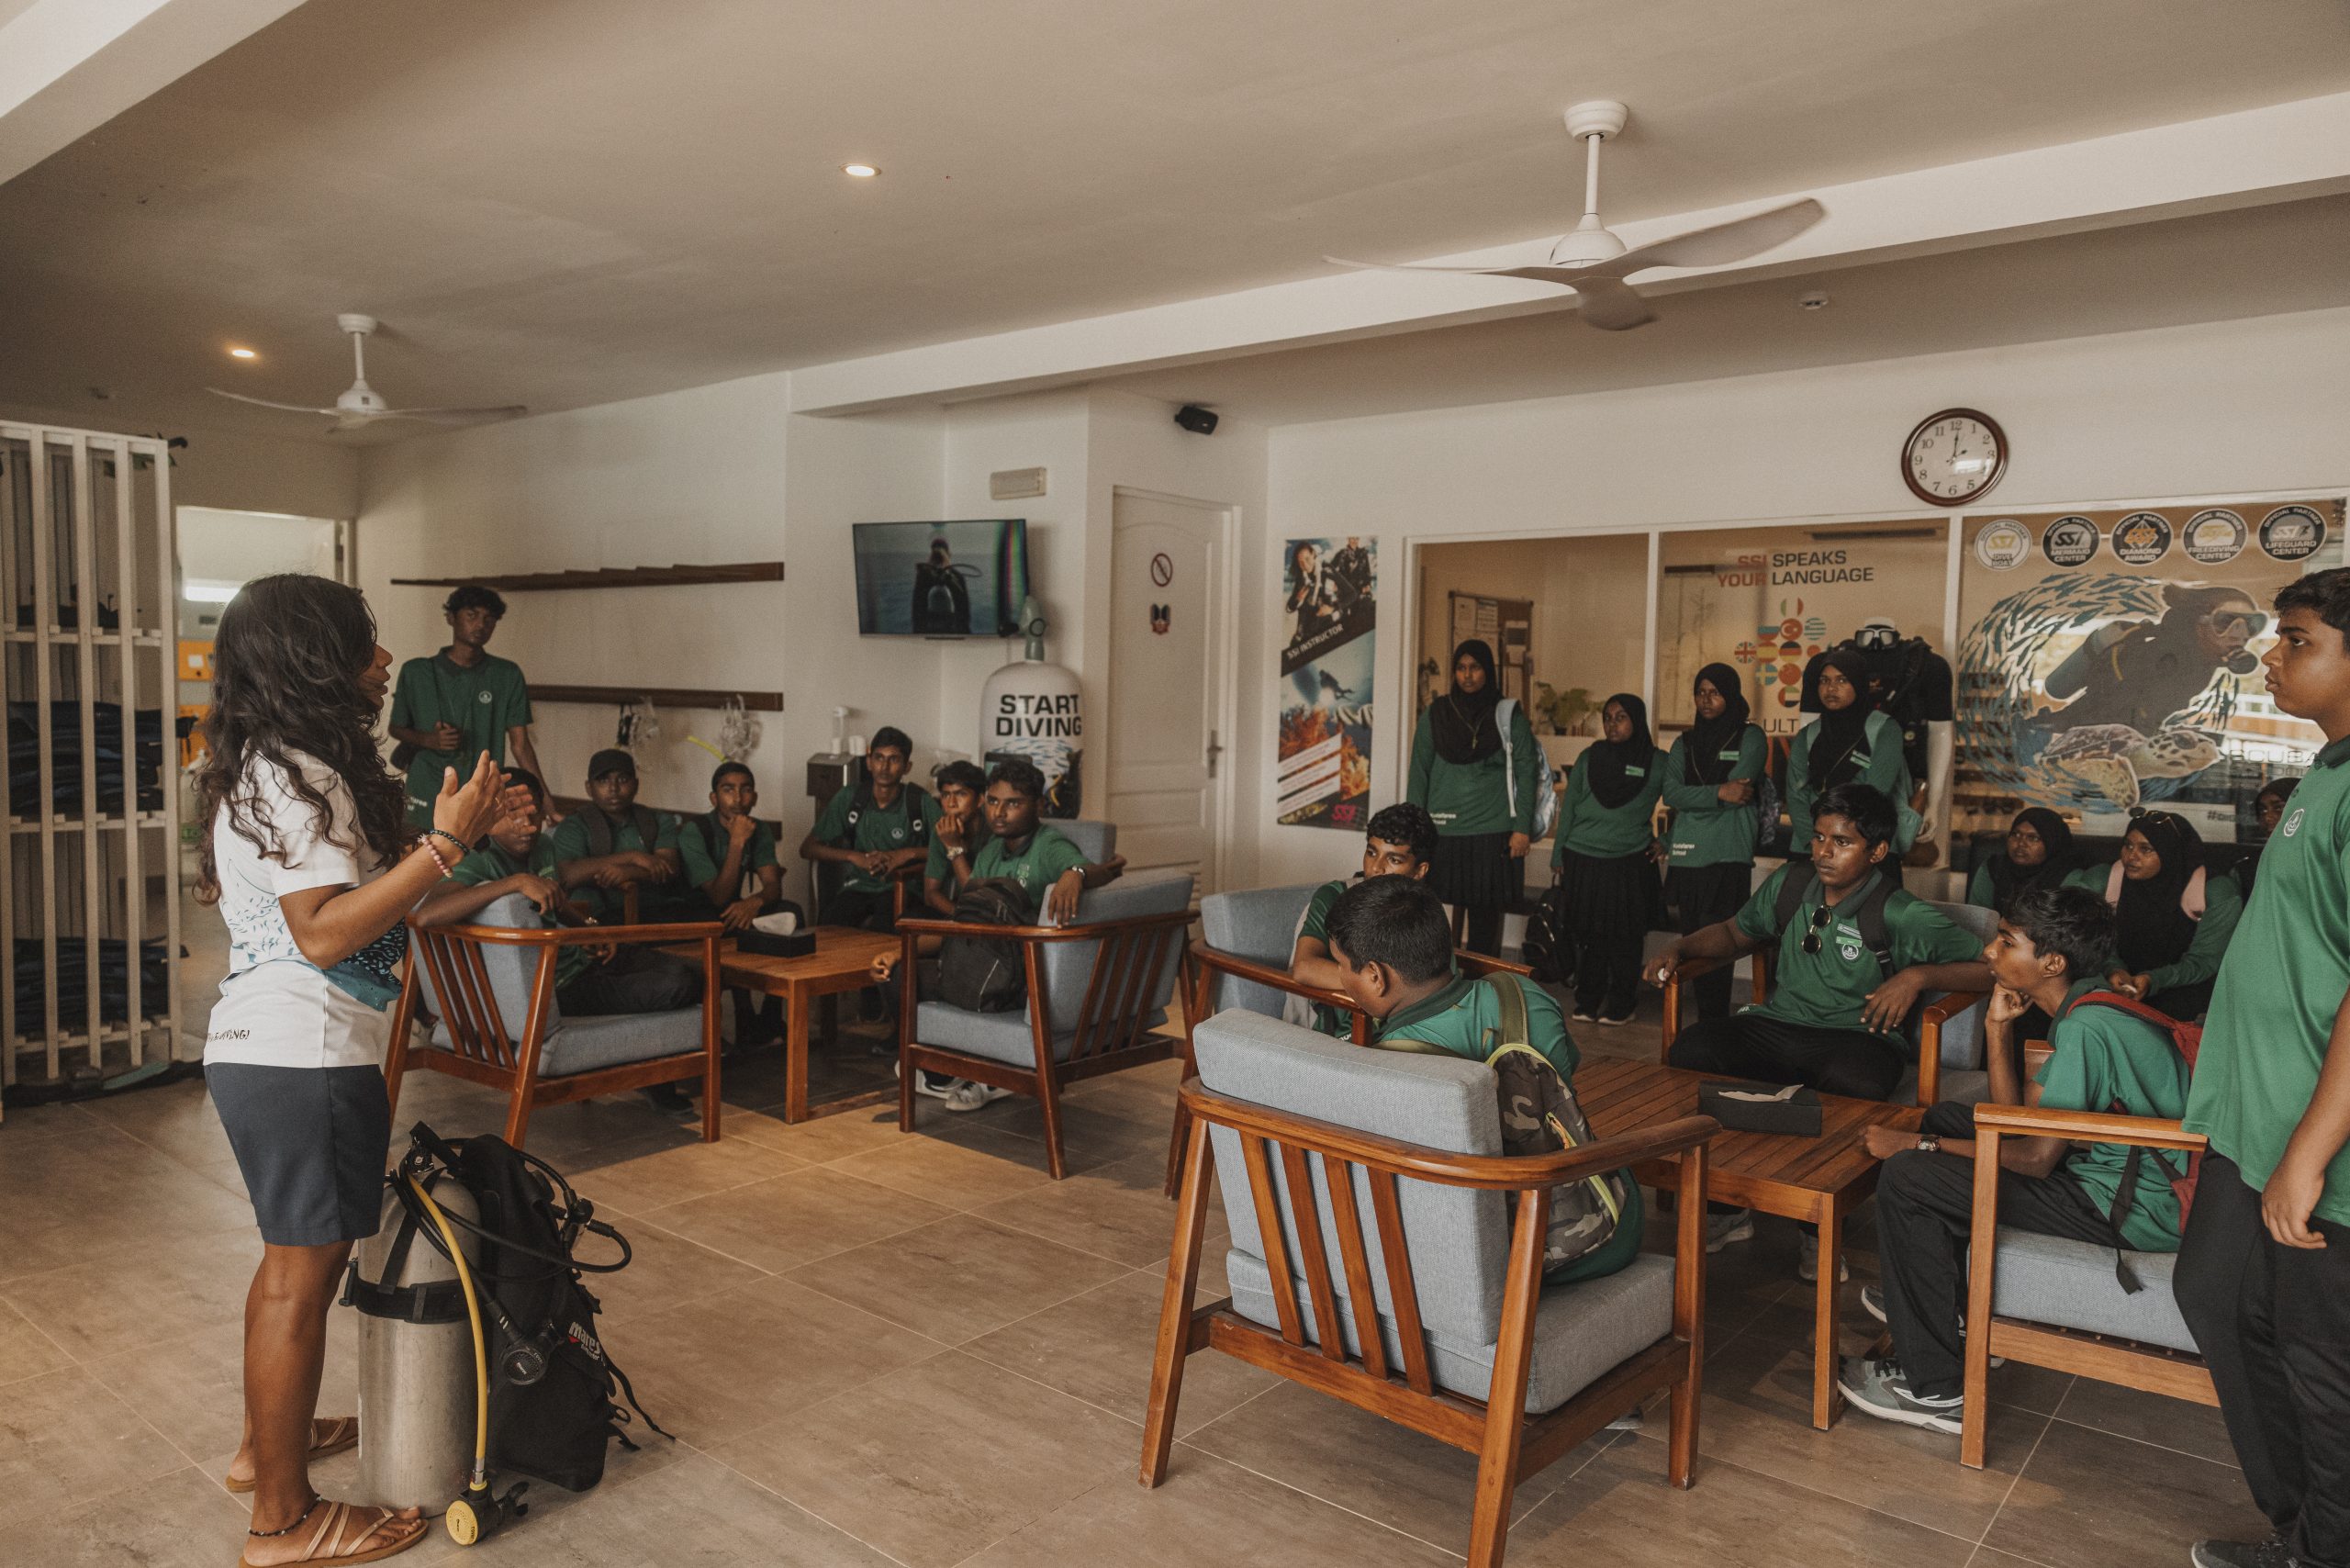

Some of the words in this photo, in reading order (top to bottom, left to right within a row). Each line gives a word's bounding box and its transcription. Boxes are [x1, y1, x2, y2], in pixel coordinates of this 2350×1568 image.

[1950, 420, 1963, 431] 12
[1971, 423, 1976, 433] 1
[1935, 426, 1944, 436] 11
[1922, 439, 1934, 449] 10
[1983, 434, 1990, 444] 2
[1915, 455, 1922, 465] 9
[1919, 470, 1927, 479] 8
[1933, 482, 1941, 491] 7
[1967, 480, 1975, 490] 5
[1948, 485, 1957, 496] 6
[2054, 531, 2085, 546] SSI
[2265, 540, 2317, 549] LIFEGUARD
[2119, 547, 2162, 555] DIAMOND
[2196, 552, 2232, 560] CENTER
[2272, 547, 2310, 555] CENTER
[1738, 554, 1767, 567] SSI
[1773, 550, 1847, 567] SPEAKS
[2054, 554, 2087, 563] CENTER
[1718, 573, 1767, 588] YOUR
[1772, 567, 1874, 586] LANGUAGE
[1300, 623, 1344, 653] INSTRUCTOR
[1000, 694, 1080, 715] START
[996, 716, 1082, 737] DIVING
